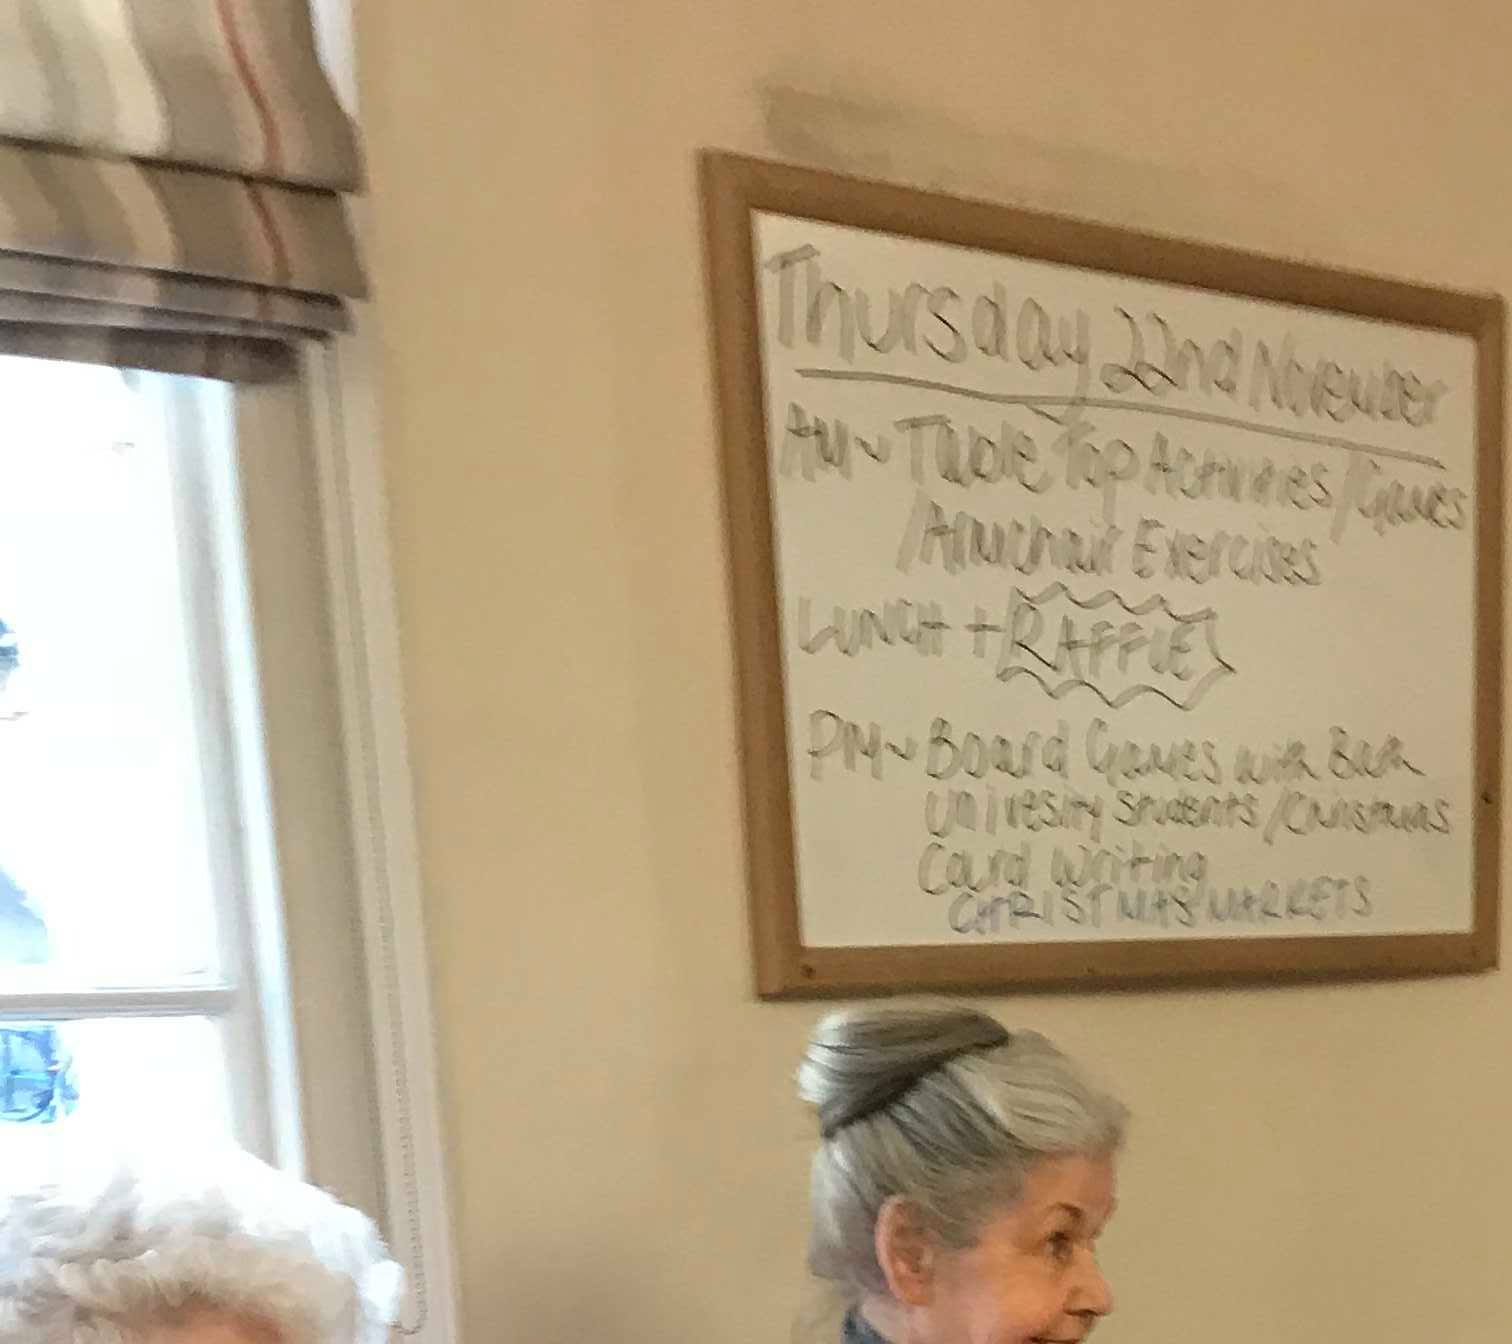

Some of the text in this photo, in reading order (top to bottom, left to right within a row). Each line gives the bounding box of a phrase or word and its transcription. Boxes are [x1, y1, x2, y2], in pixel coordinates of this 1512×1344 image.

[763, 243, 1091, 420] Thursday
[1101, 304, 1243, 396] 22nd
[1002, 597, 1198, 681] RAFFLE
[925, 716, 1070, 781] Board
[917, 841, 1032, 896] Card
